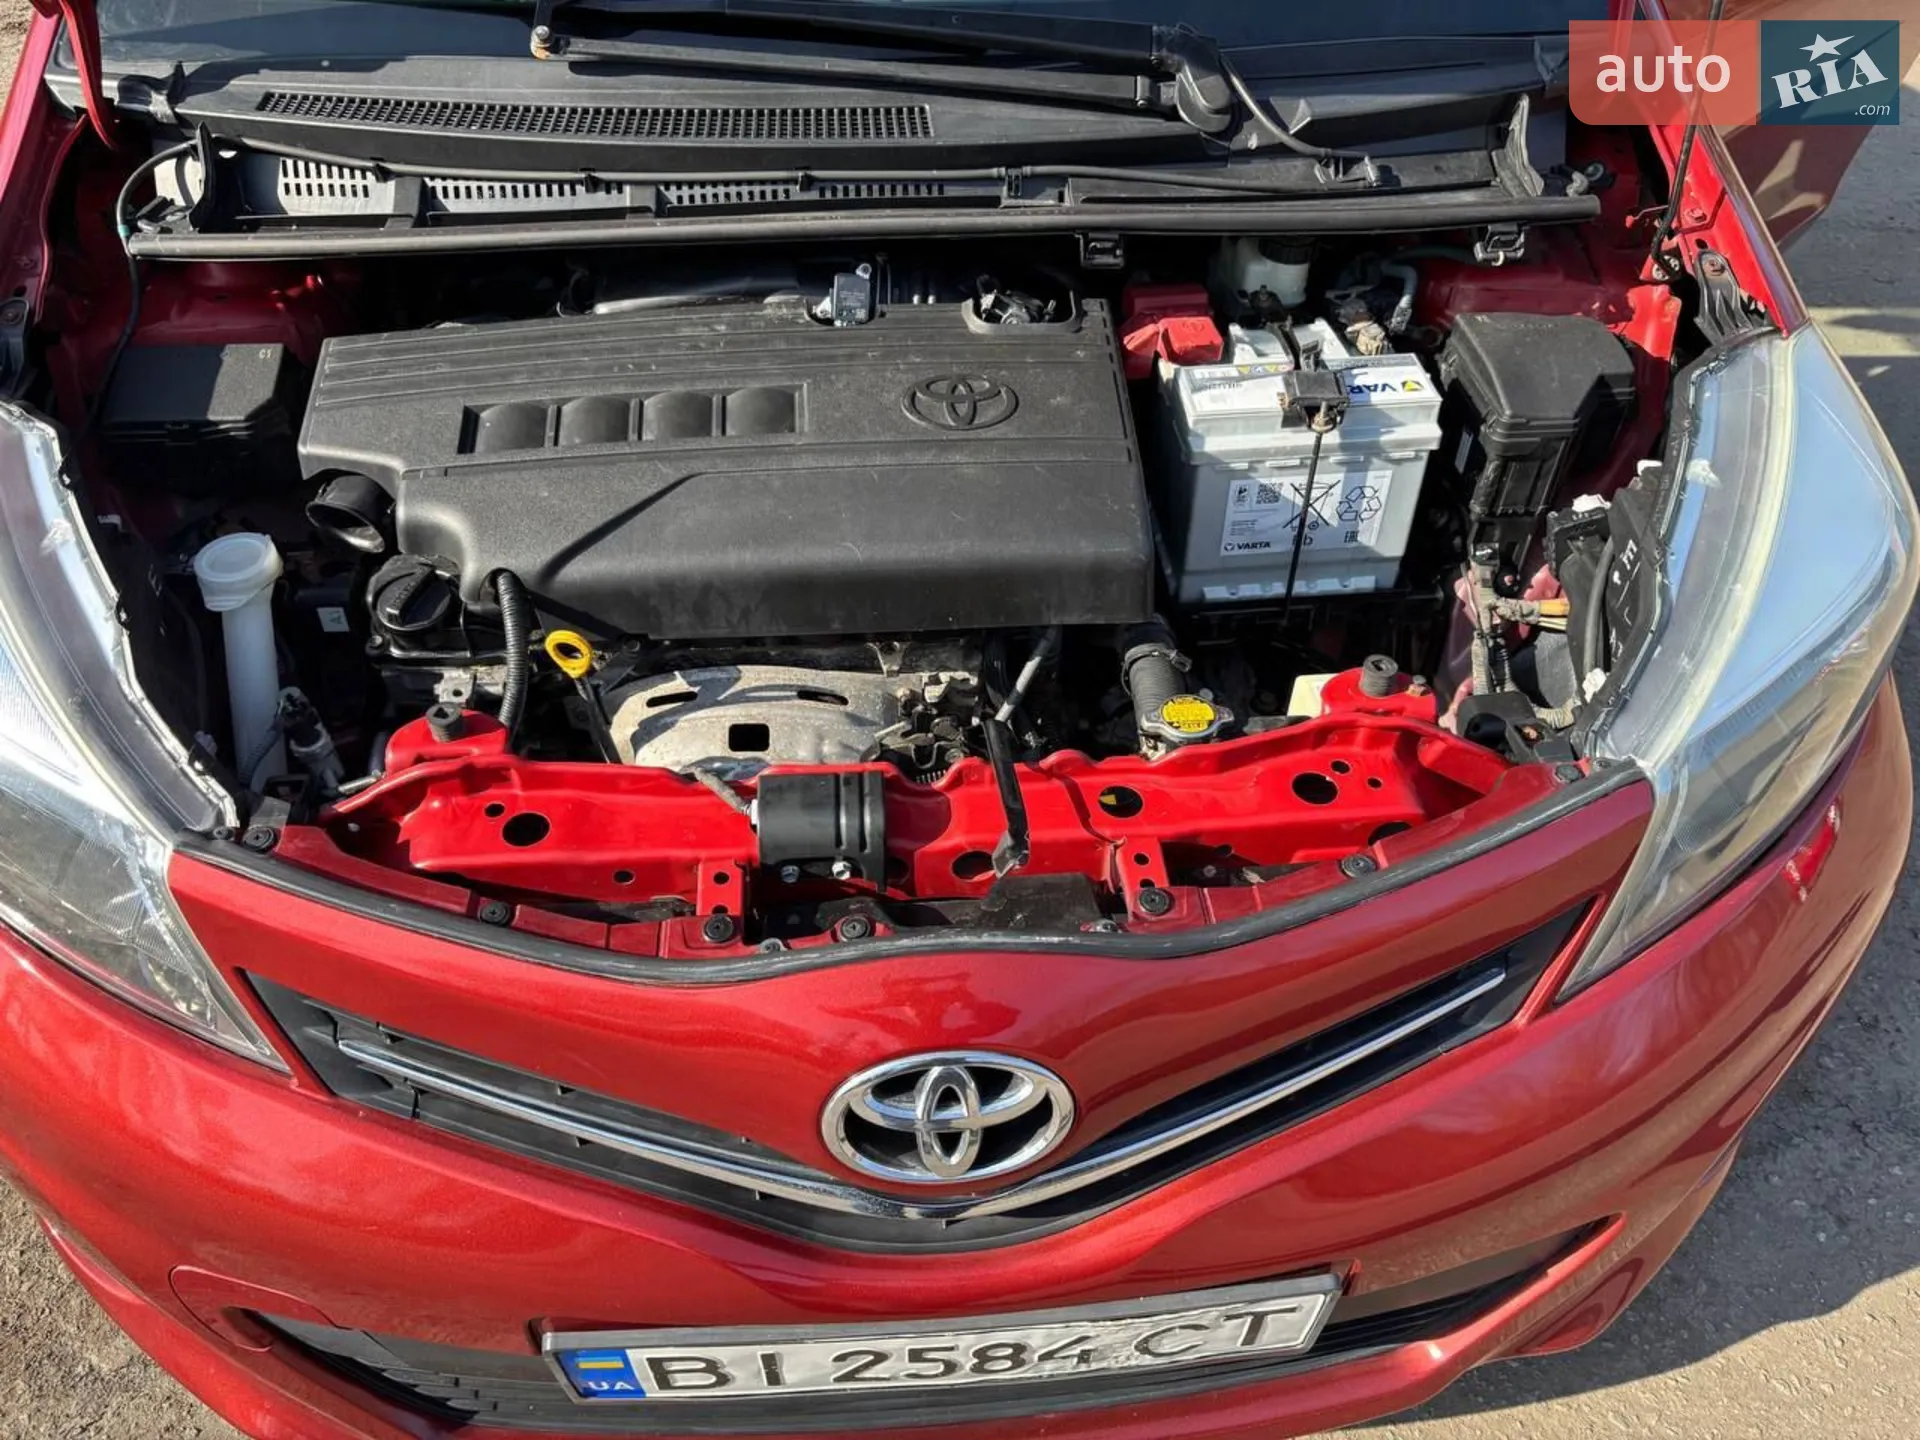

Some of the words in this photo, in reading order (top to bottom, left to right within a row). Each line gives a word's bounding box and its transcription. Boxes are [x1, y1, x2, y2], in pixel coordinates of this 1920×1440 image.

[1345, 382, 1398, 395] VAR
[1236, 541, 1271, 550] VARTA
[646, 1352, 786, 1391] BI
[830, 1335, 1099, 1384] 2584
[1134, 1305, 1301, 1359] CT
[588, 1379, 635, 1391] UA
